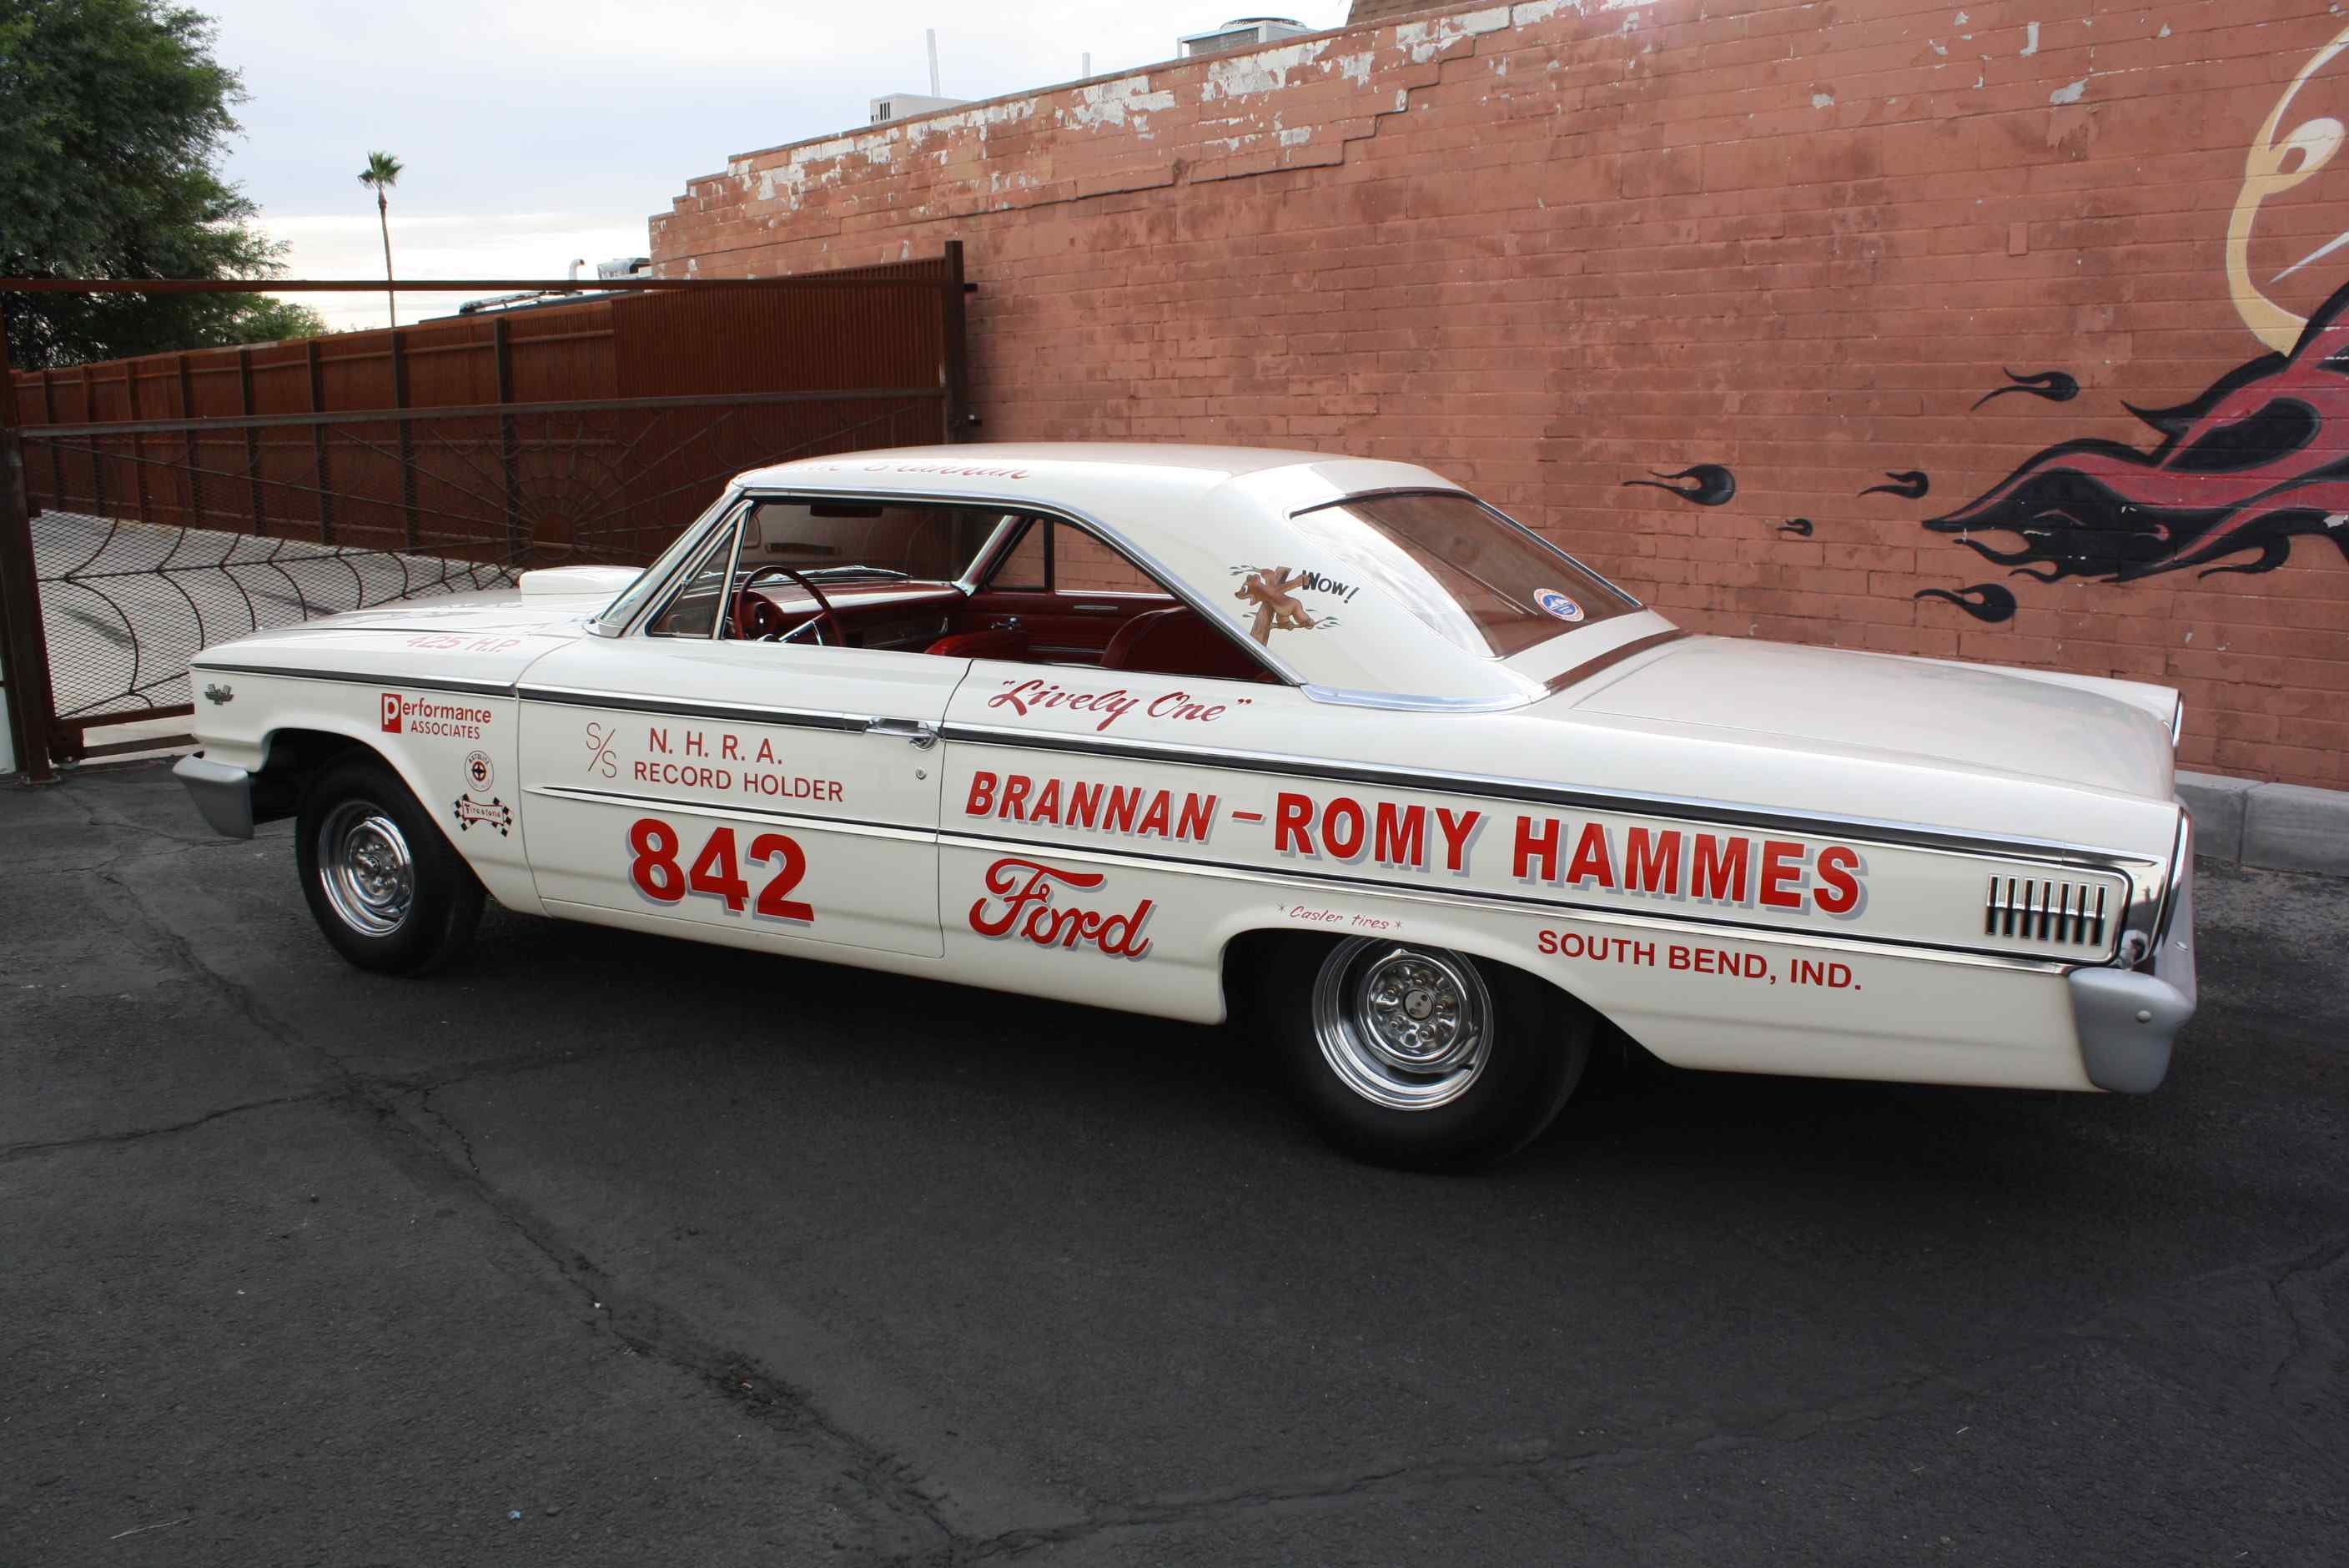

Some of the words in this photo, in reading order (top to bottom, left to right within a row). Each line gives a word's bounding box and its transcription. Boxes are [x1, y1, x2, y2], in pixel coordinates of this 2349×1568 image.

[406, 636, 470, 650] 425
[410, 721, 480, 741] ASSOCIATES
[634, 761, 732, 790] RECORD
[743, 772, 845, 802] HOLDER
[965, 771, 1220, 845] BRANNAN
[1274, 792, 1488, 877] ROMY
[1512, 815, 1868, 920] HAMMES
[628, 817, 815, 927] 842
[968, 857, 1158, 962] Ford
[1290, 906, 1343, 922] Casler
[1351, 914, 1389, 930] tires
[1537, 929, 1657, 967] SOUTH
[1668, 945, 1778, 984] BEND,
[1789, 958, 1863, 990] IND.
